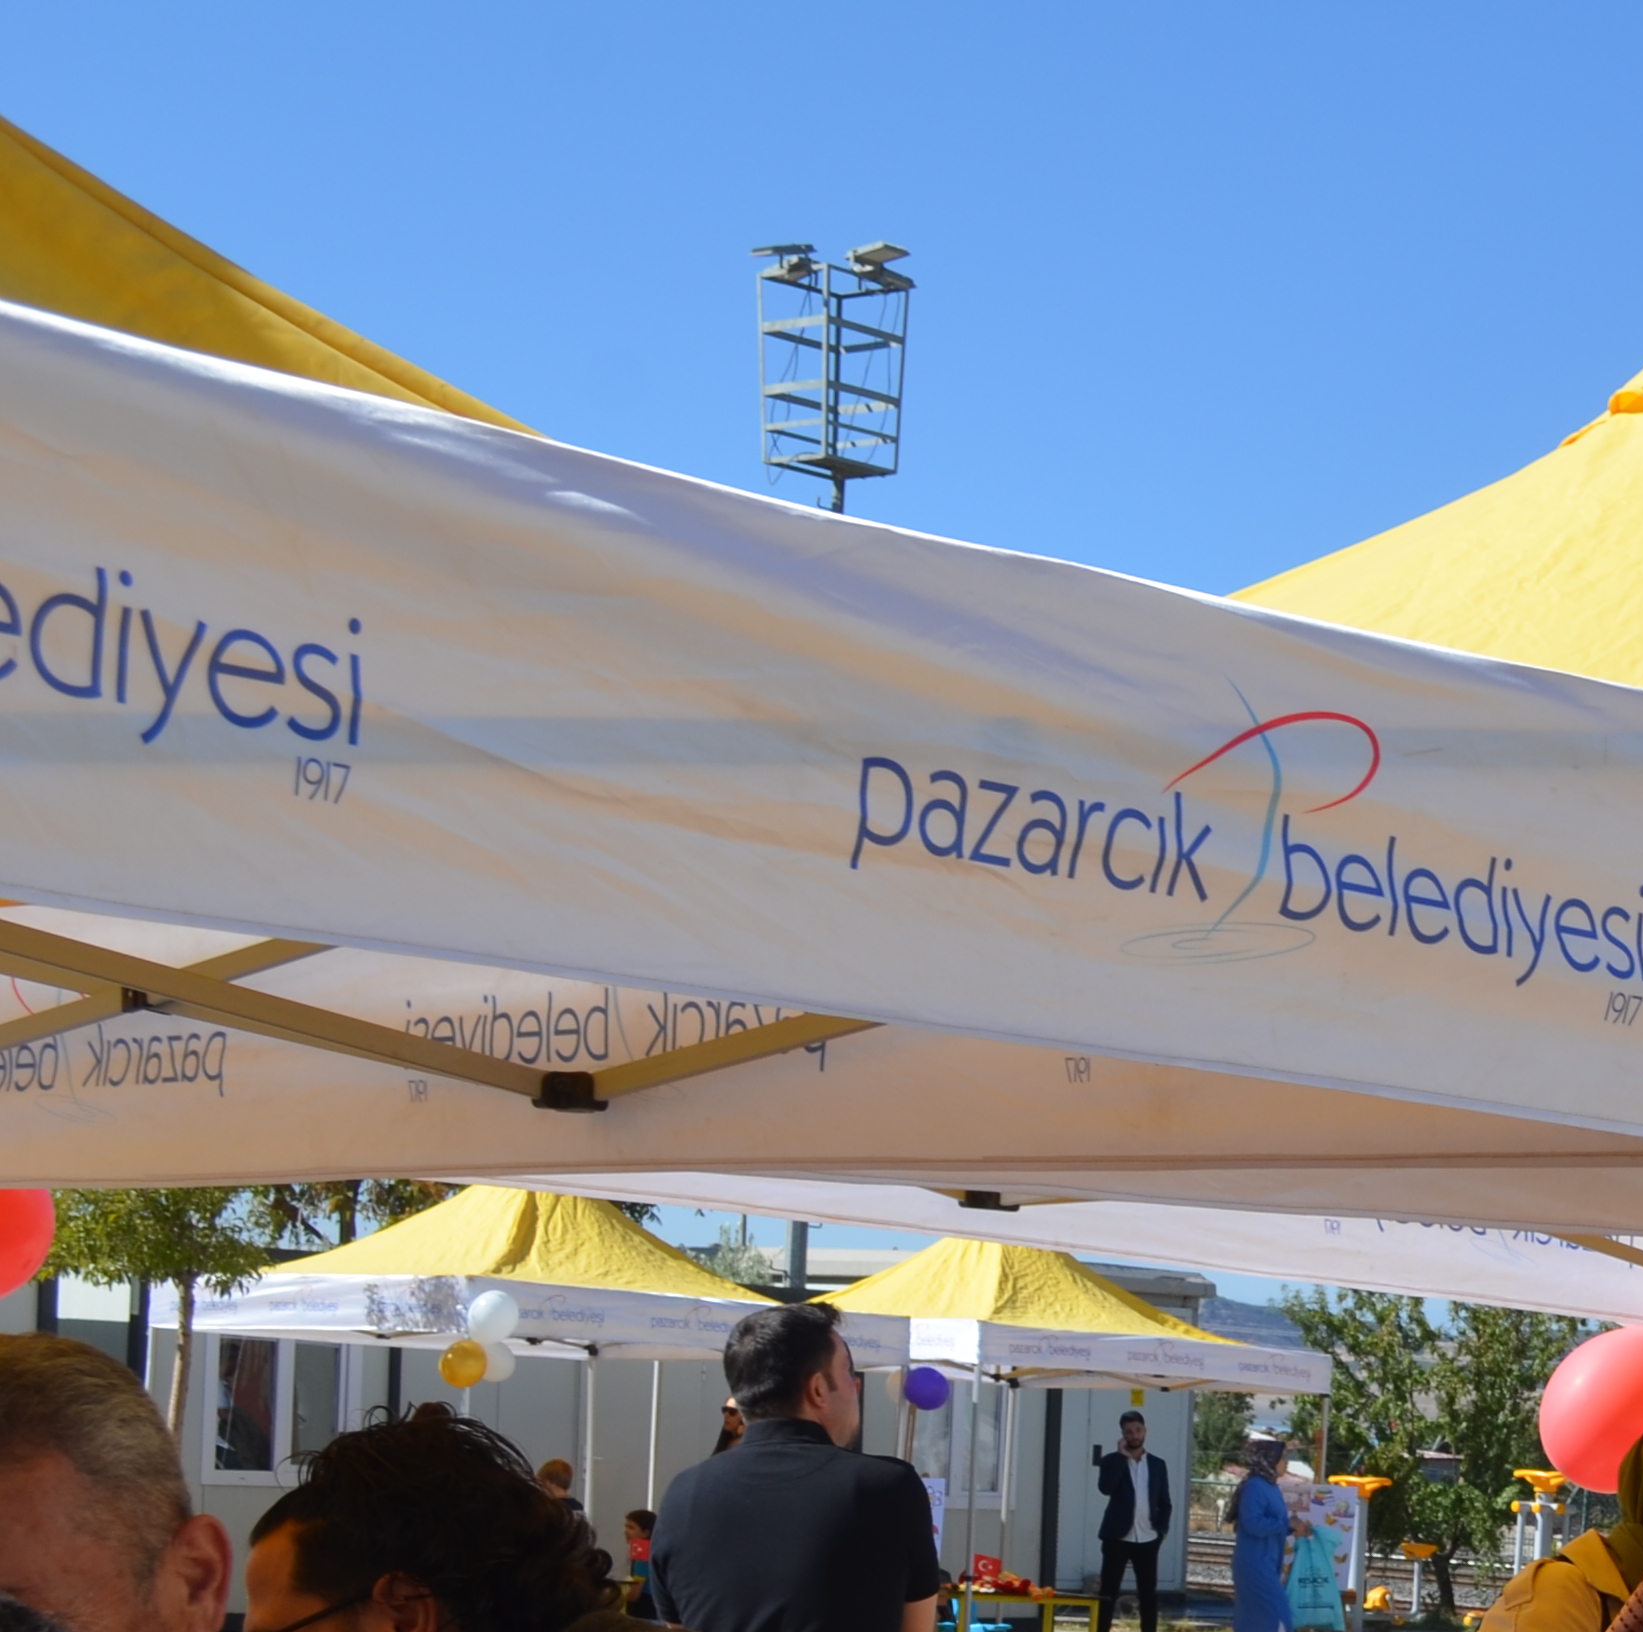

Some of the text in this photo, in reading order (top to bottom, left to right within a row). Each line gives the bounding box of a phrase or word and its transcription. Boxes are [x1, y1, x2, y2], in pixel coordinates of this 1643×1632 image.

[0, 566, 362, 746] diyesi
[295, 756, 352, 804] 1917
[849, 756, 1212, 902] pazarcık
[1603, 991, 1643, 1026] 1917
